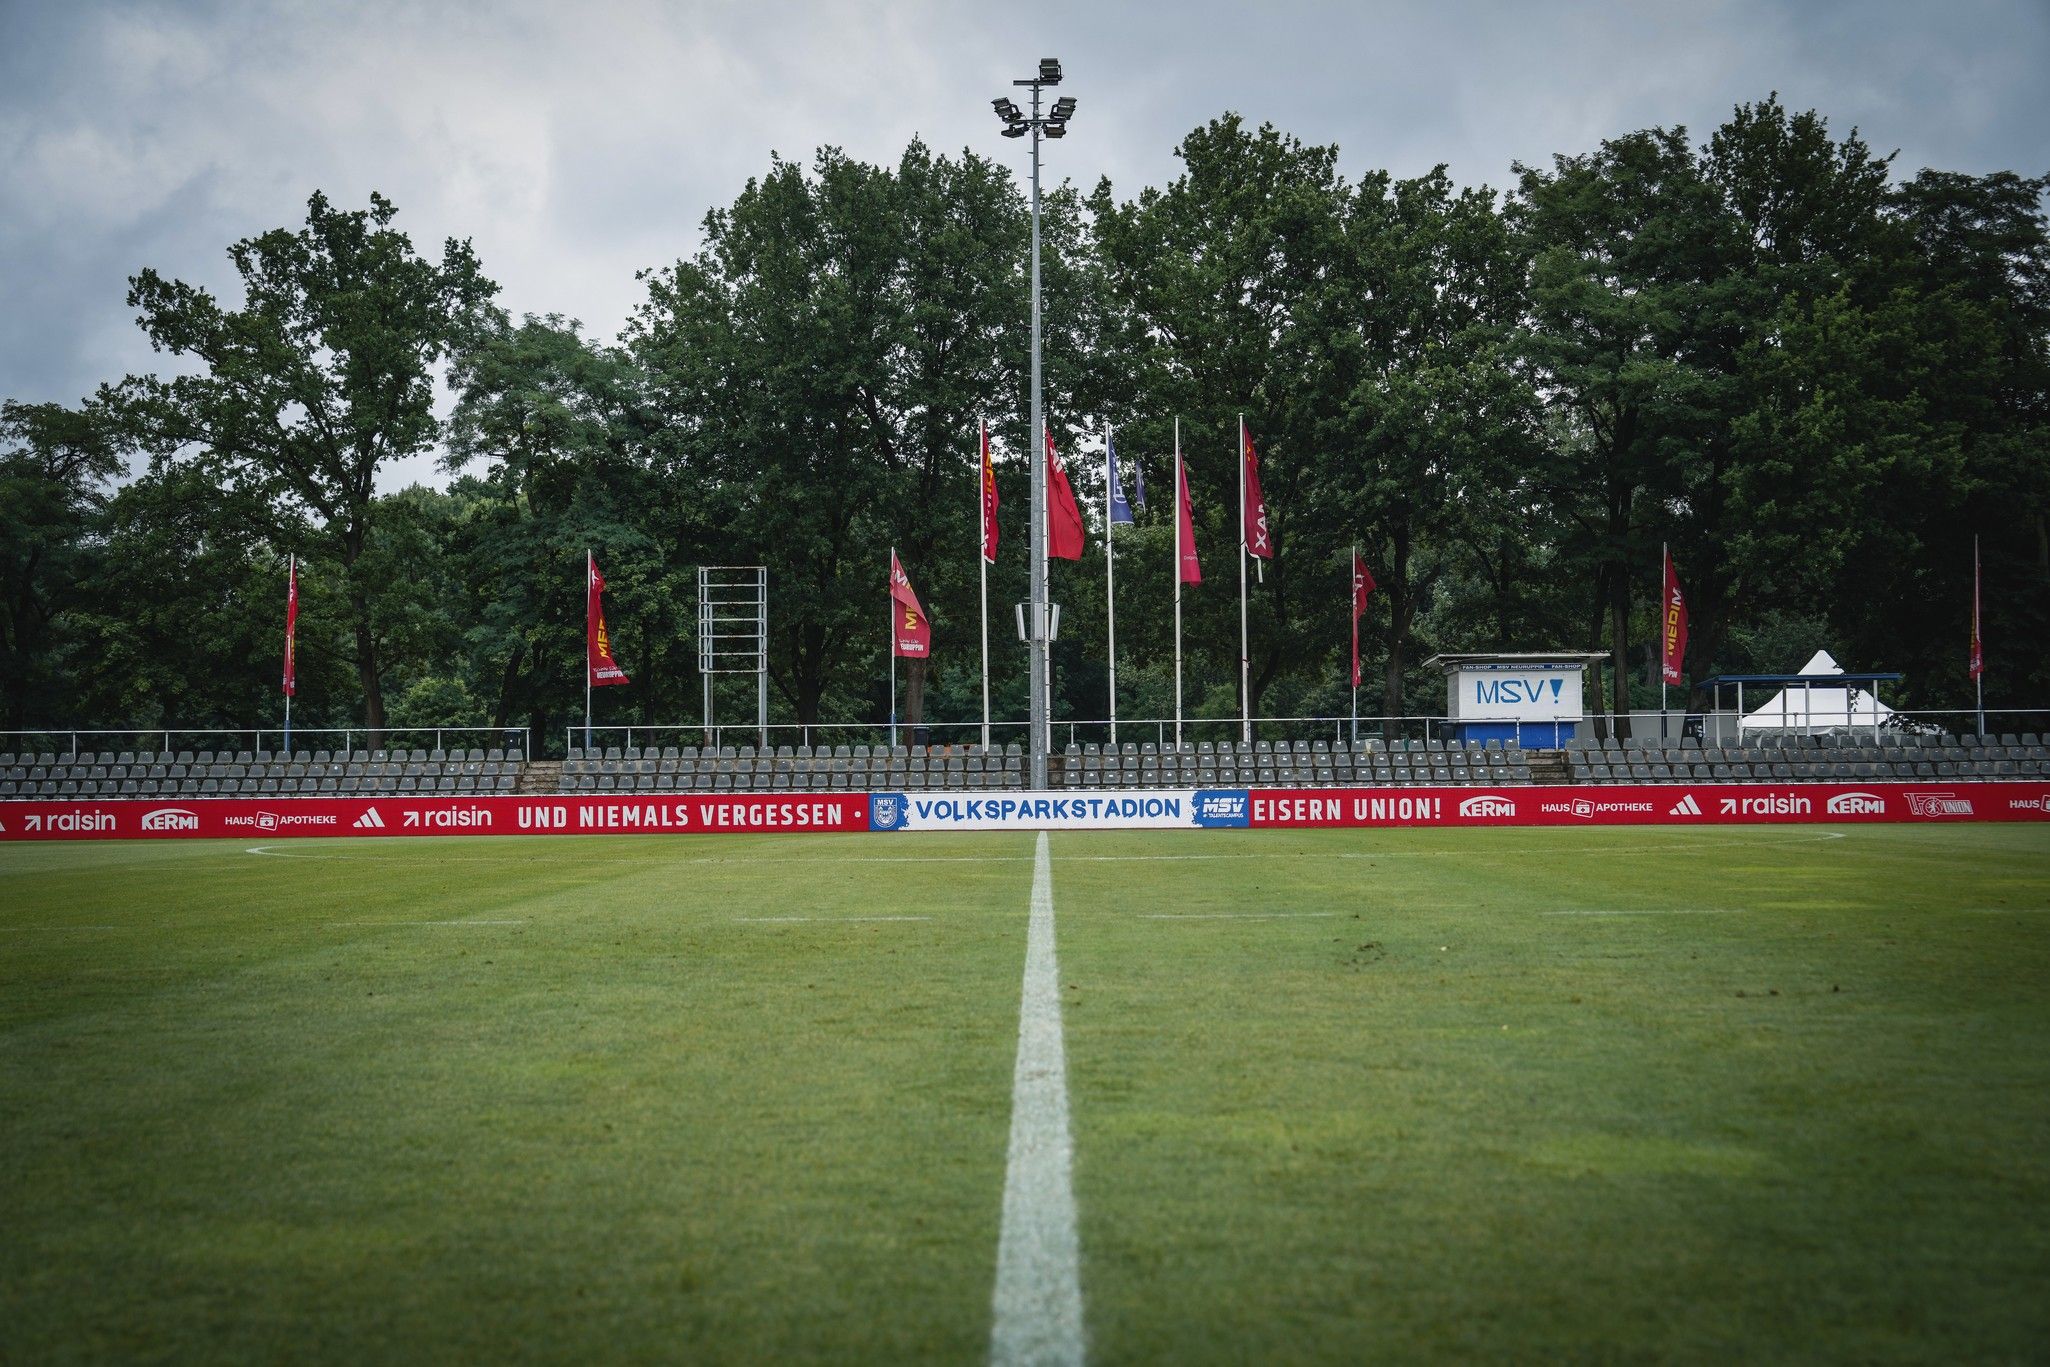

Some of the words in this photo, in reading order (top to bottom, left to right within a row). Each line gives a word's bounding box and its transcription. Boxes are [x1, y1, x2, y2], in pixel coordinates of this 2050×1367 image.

[916, 799, 1180, 821] VOLKSPARKSTADION
[1203, 797, 1245, 813] MSV
[1254, 799, 1341, 821] EISERN
[1354, 798, 1440, 820] UNION!
[1459, 797, 1516, 818] KERMI
[1541, 804, 1570, 812] HAUS
[1596, 803, 1653, 812] APOTHEKE
[1742, 793, 1811, 814] raisin
[1827, 794, 1885, 814] KERMI
[2009, 800, 2040, 809] HAUS
[47, 809, 116, 831] raisin
[141, 808, 198, 830] KERMI
[225, 816, 254, 825] HAUS
[280, 815, 337, 824] APOTHEKE
[425, 805, 492, 826] raisin
[518, 806, 566, 828] UND
[579, 805, 689, 828] NIEMALS
[700, 803, 842, 827] VERGESSEN
